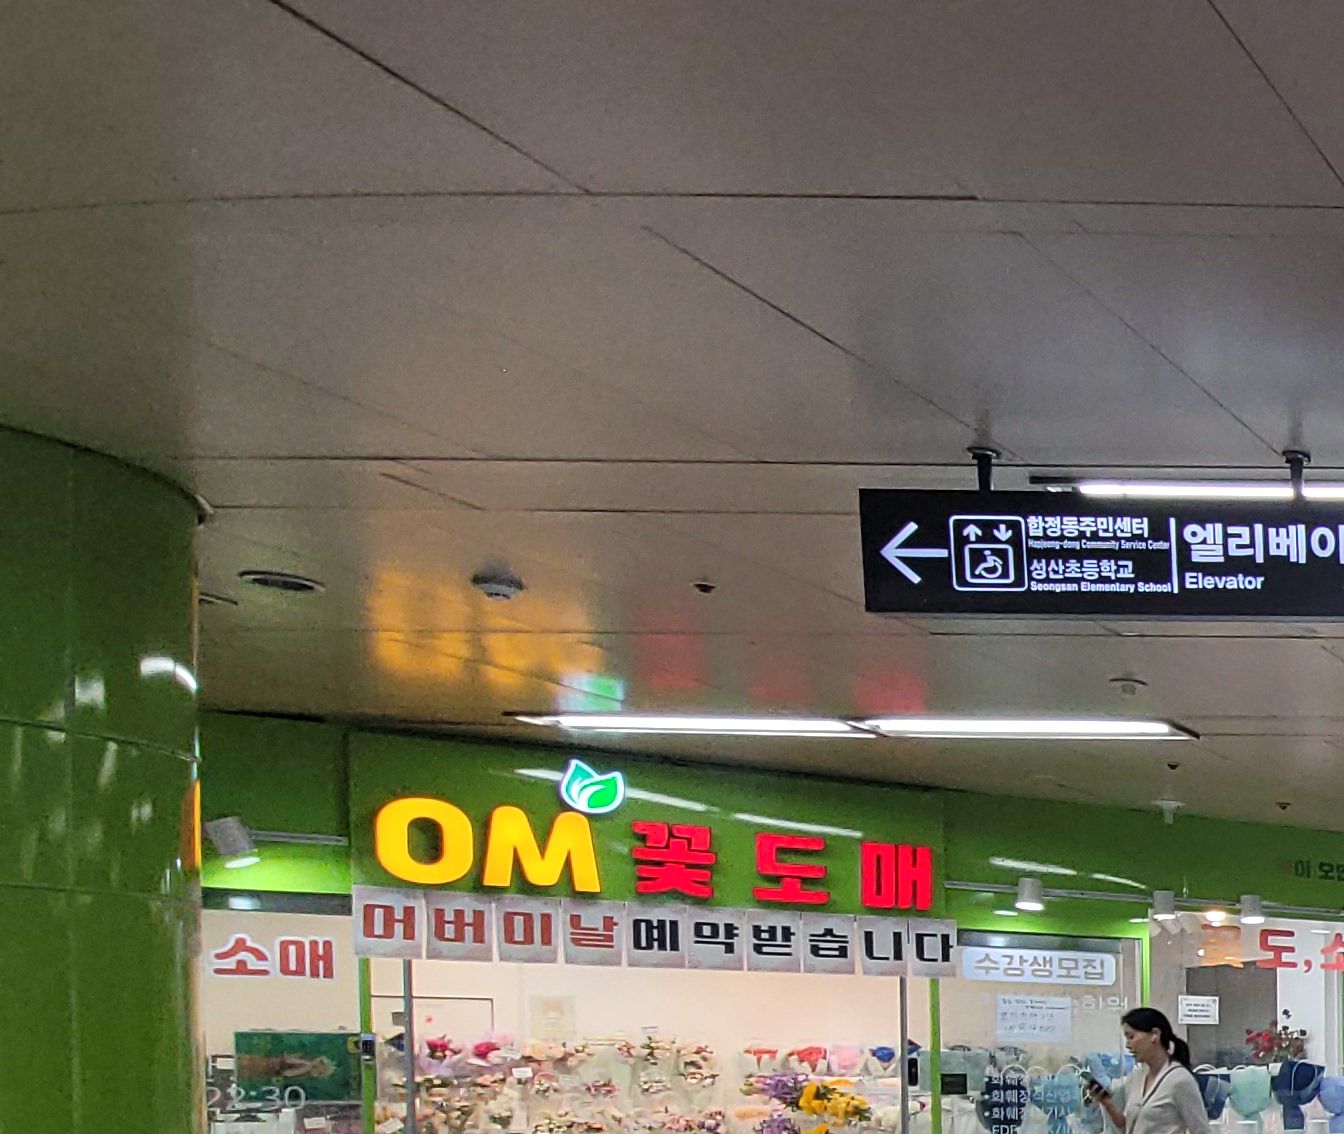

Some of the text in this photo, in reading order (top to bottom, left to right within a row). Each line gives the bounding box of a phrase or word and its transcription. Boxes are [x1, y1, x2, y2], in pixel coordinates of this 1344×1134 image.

[1026, 515, 1149, 538] 합정동주민센터
[1081, 540, 1120, 550] Community
[1121, 540, 1146, 549] Service
[1147, 541, 1170, 550] Center
[1029, 559, 1135, 580] 성산초등학교
[1030, 581, 1172, 593] Seongsan Elementary School
[1184, 572, 1265, 590] Elevator
[373, 797, 602, 894] OM
[212, 936, 335, 980] 소매
[973, 952, 1106, 981] 수강생모집
